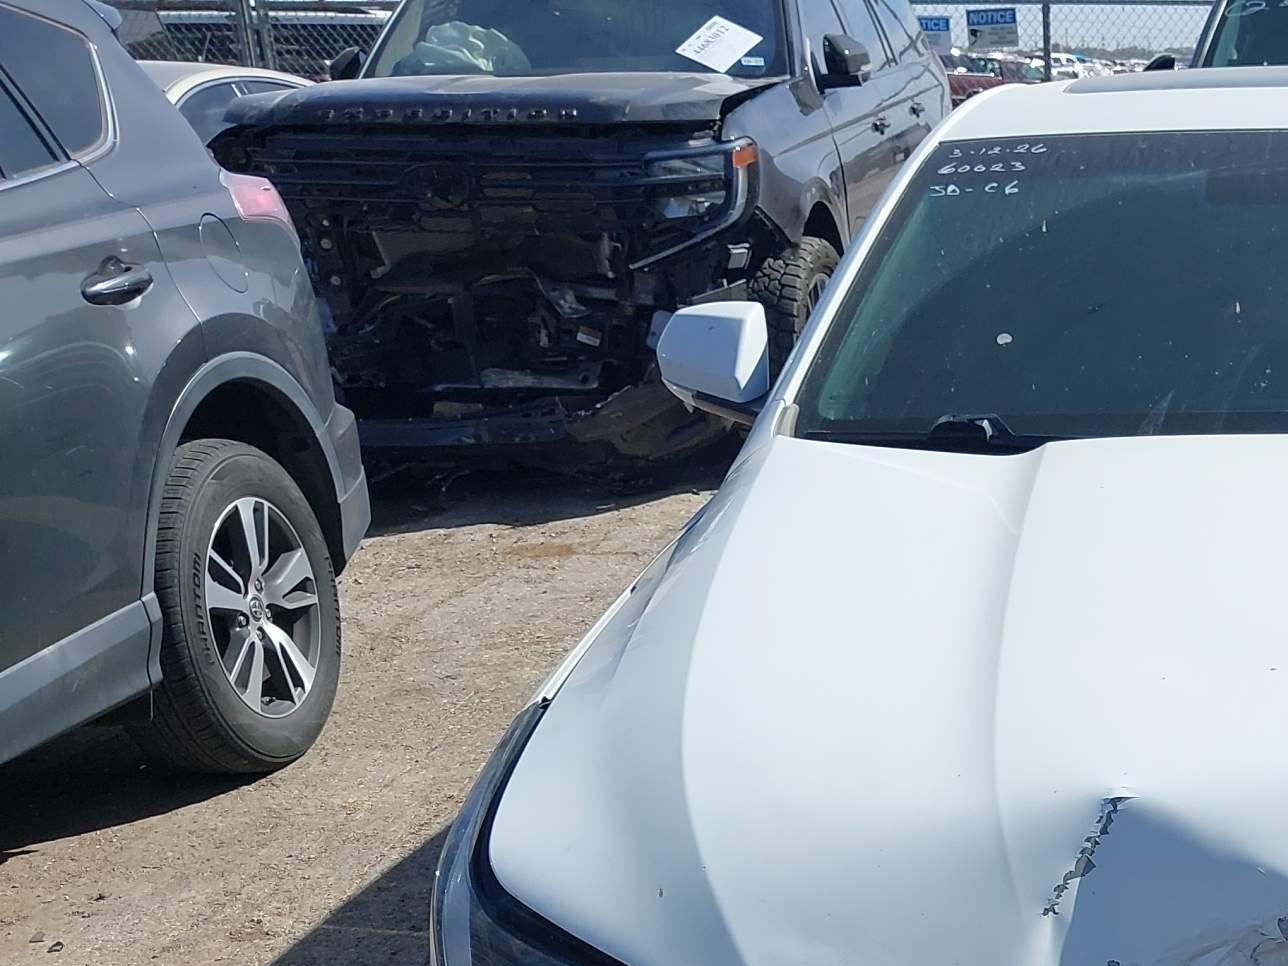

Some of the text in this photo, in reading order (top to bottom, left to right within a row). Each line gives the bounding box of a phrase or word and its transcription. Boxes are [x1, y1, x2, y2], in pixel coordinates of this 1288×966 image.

[968, 10, 1014, 25] NOTICE
[920, 19, 947, 30] TICE
[937, 162, 1026, 175] 60023
